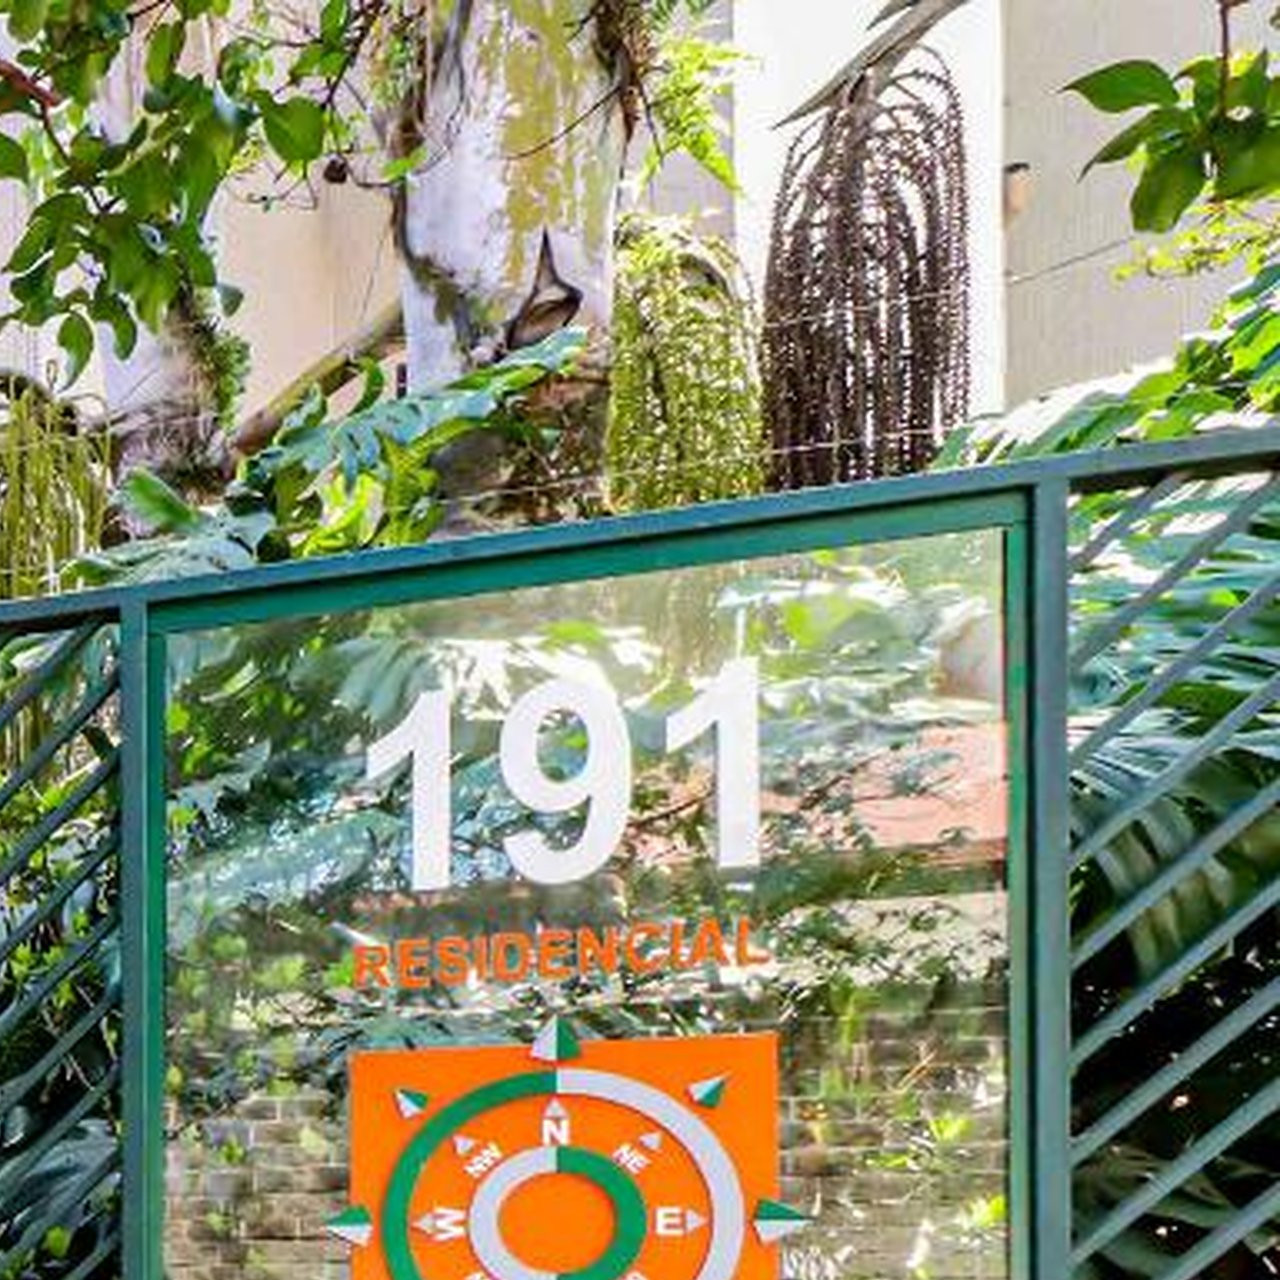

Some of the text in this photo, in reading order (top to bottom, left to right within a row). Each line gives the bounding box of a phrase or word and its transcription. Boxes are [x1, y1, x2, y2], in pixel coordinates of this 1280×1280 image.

[366, 656, 761, 893] 191
[352, 917, 770, 989] RESIDENCIAL
[543, 1119, 571, 1146] N
[614, 1144, 650, 1174] NE
[435, 1207, 468, 1241] W
[656, 1207, 684, 1236] E
